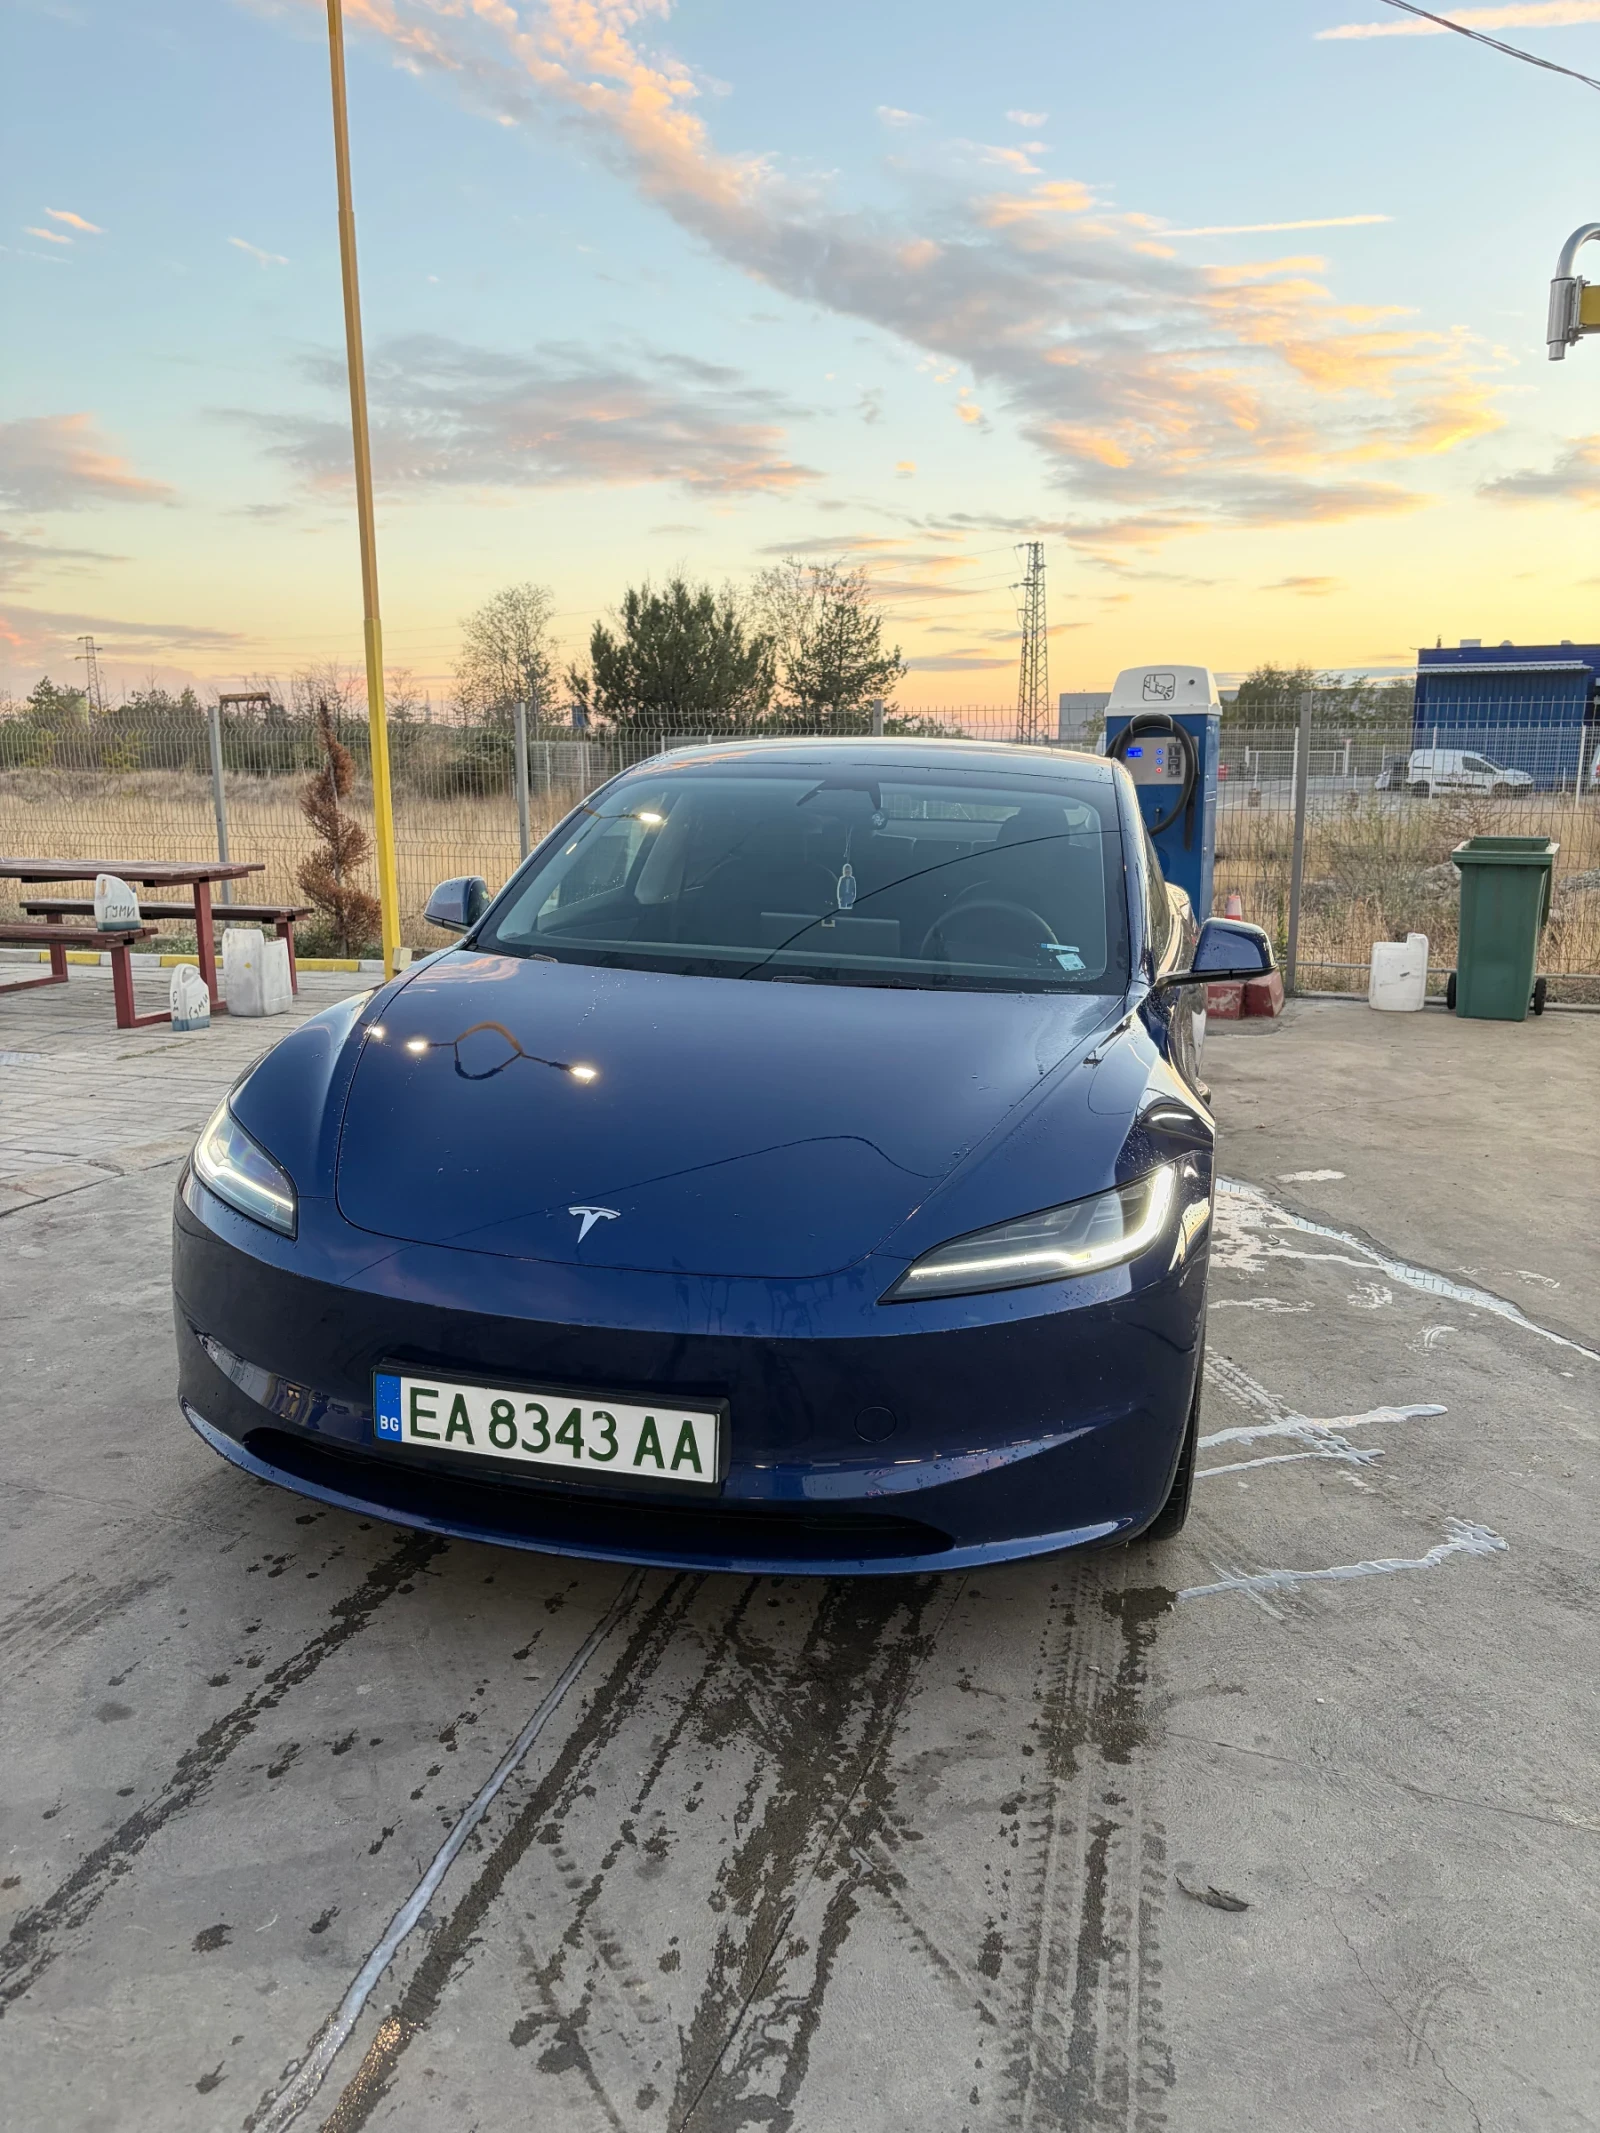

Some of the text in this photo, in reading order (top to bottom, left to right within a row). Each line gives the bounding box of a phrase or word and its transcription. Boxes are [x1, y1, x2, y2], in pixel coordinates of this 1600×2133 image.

[105, 904, 136, 919] ГУМИ
[379, 1414, 399, 1432] BG
[410, 1386, 703, 1473] EA 8343 AA
